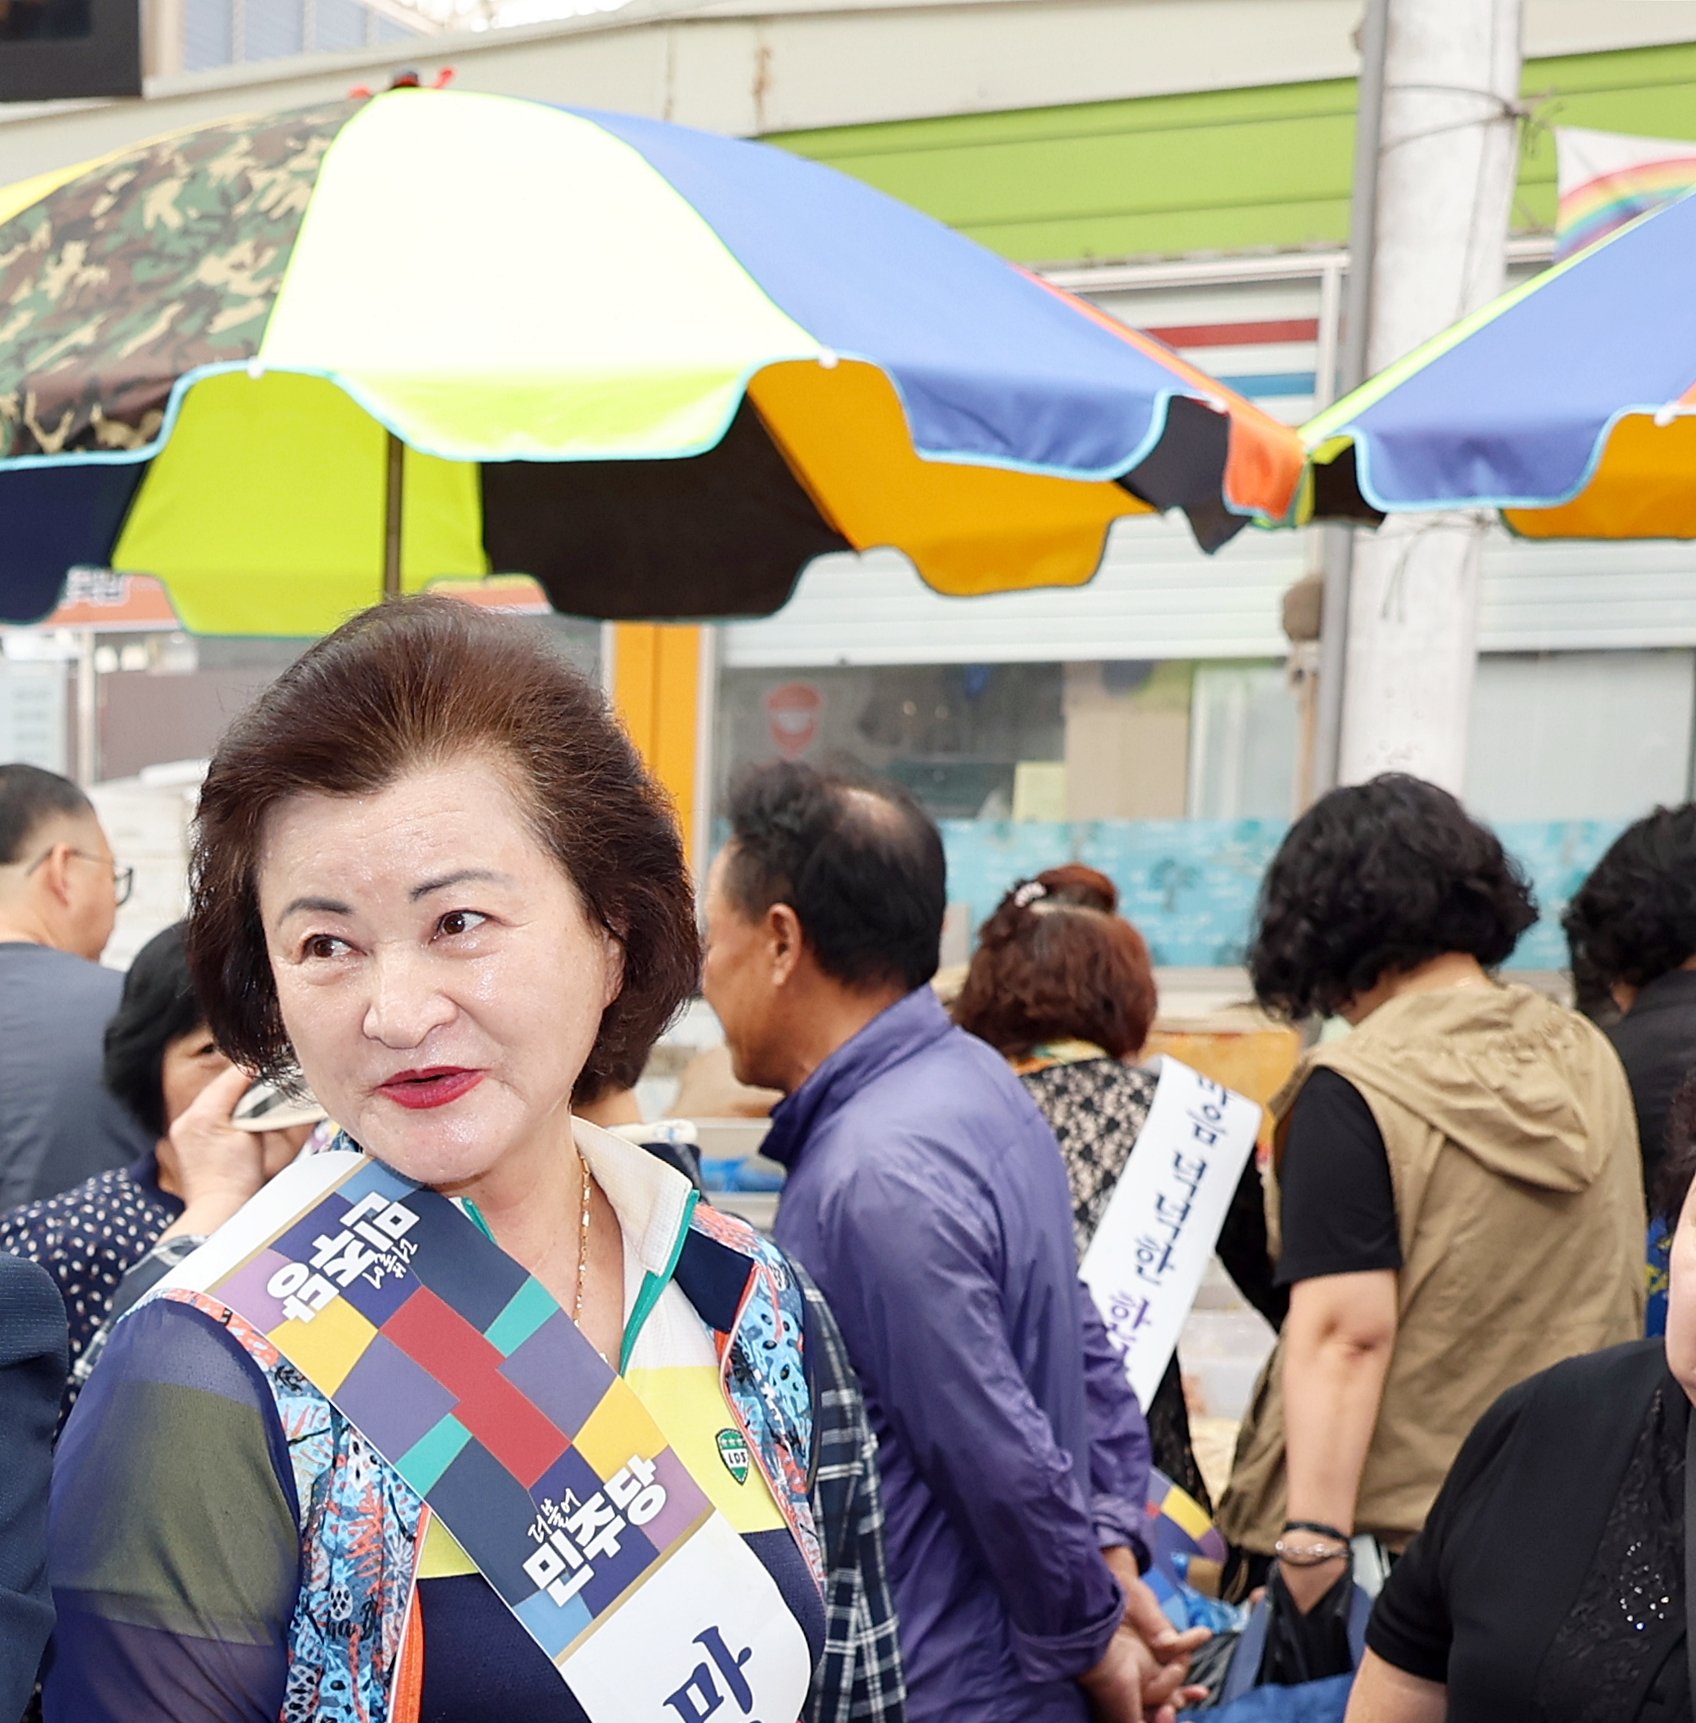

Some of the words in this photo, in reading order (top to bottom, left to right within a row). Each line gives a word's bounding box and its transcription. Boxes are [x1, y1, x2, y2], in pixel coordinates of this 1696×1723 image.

[266, 1191, 421, 1324] 민주당
[361, 1238, 418, 1289] 더불어
[522, 1454, 668, 1608] 민주당
[527, 1487, 582, 1543] 더불어
